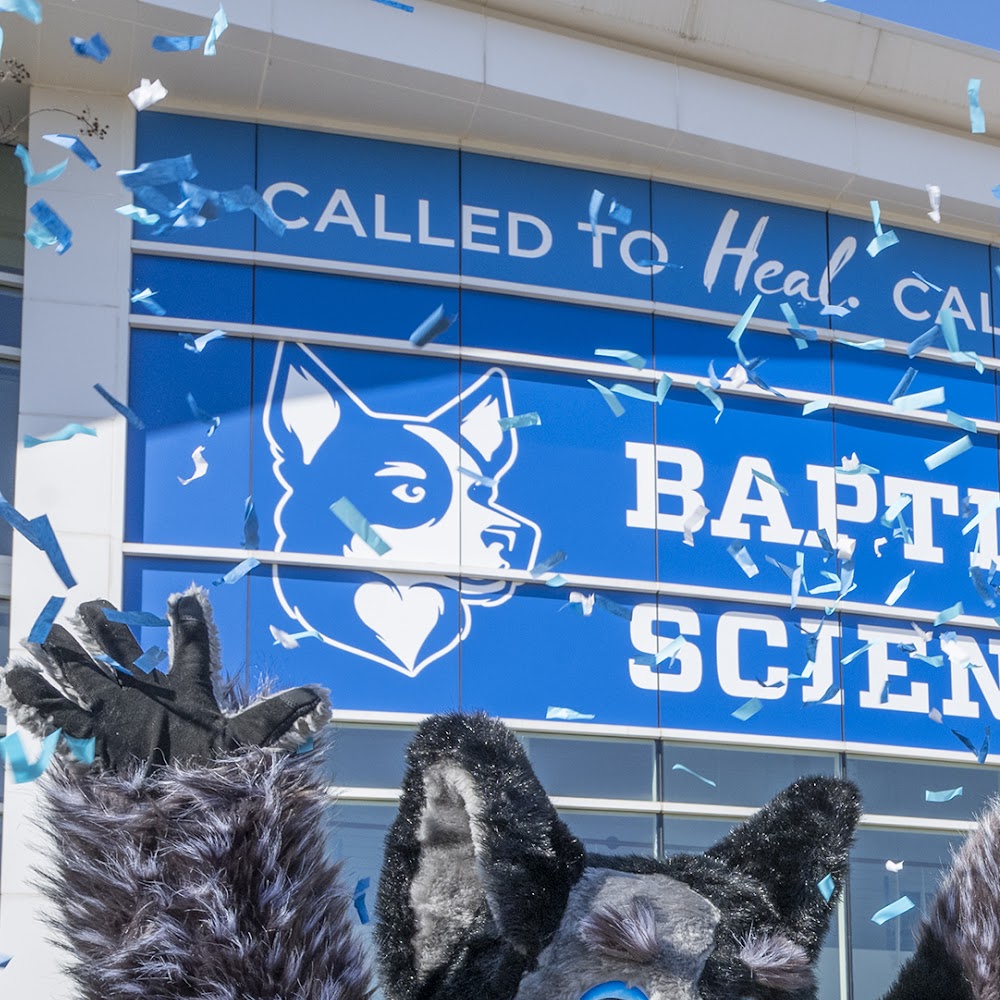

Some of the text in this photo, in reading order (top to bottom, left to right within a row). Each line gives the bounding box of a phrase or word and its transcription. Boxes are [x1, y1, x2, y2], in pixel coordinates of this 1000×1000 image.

[261, 182, 553, 259] CALLED
[577, 221, 669, 275] TO
[703, 208, 859, 309] Heal.
